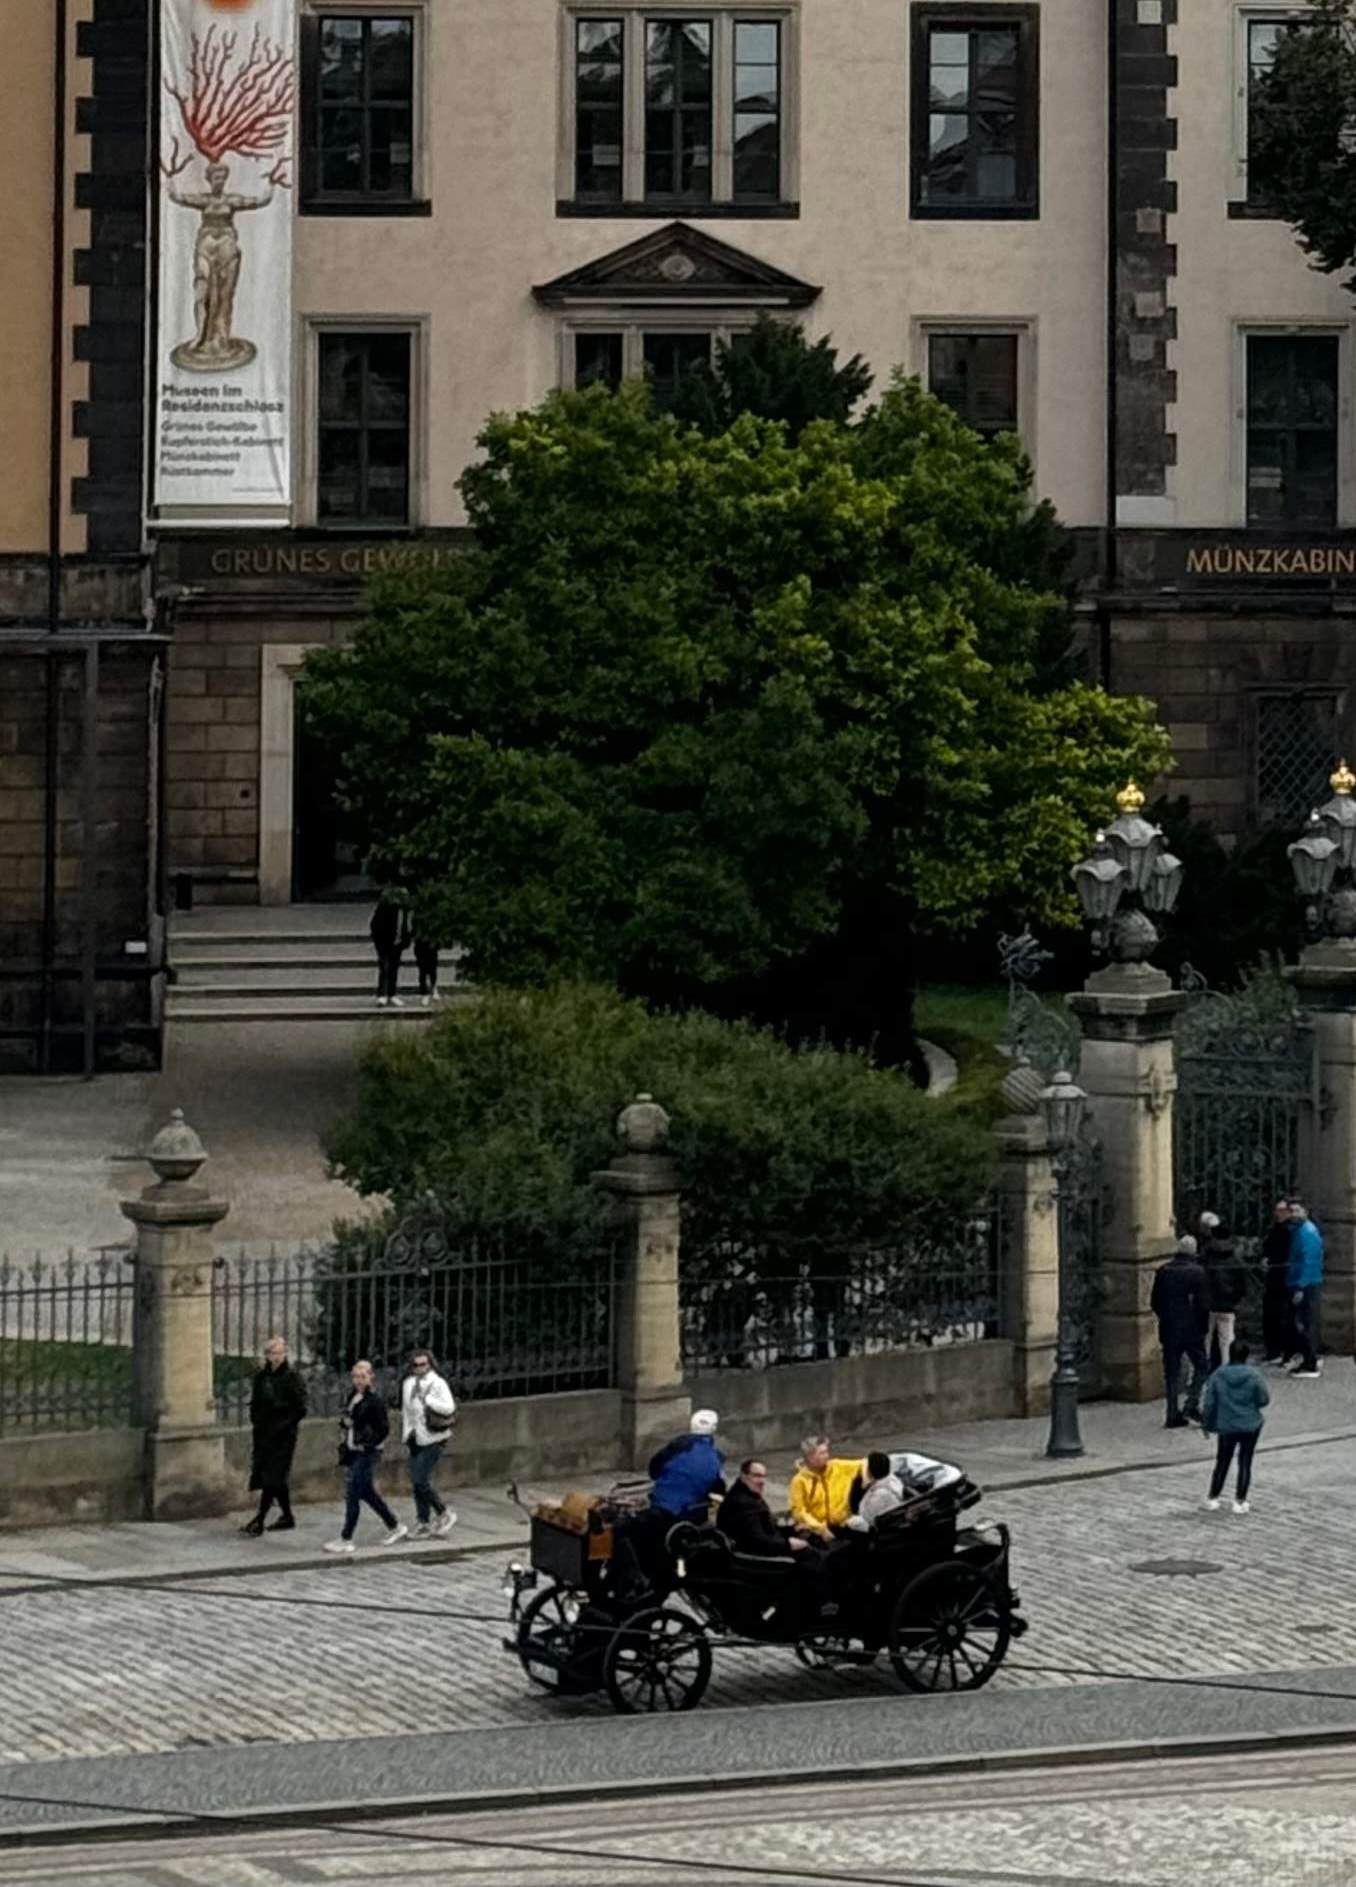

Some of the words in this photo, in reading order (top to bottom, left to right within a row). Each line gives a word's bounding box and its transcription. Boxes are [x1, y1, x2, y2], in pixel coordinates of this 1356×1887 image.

[161, 383, 219, 397] Museen
[222, 383, 243, 397] im
[211, 543, 330, 573] GRÜNES
